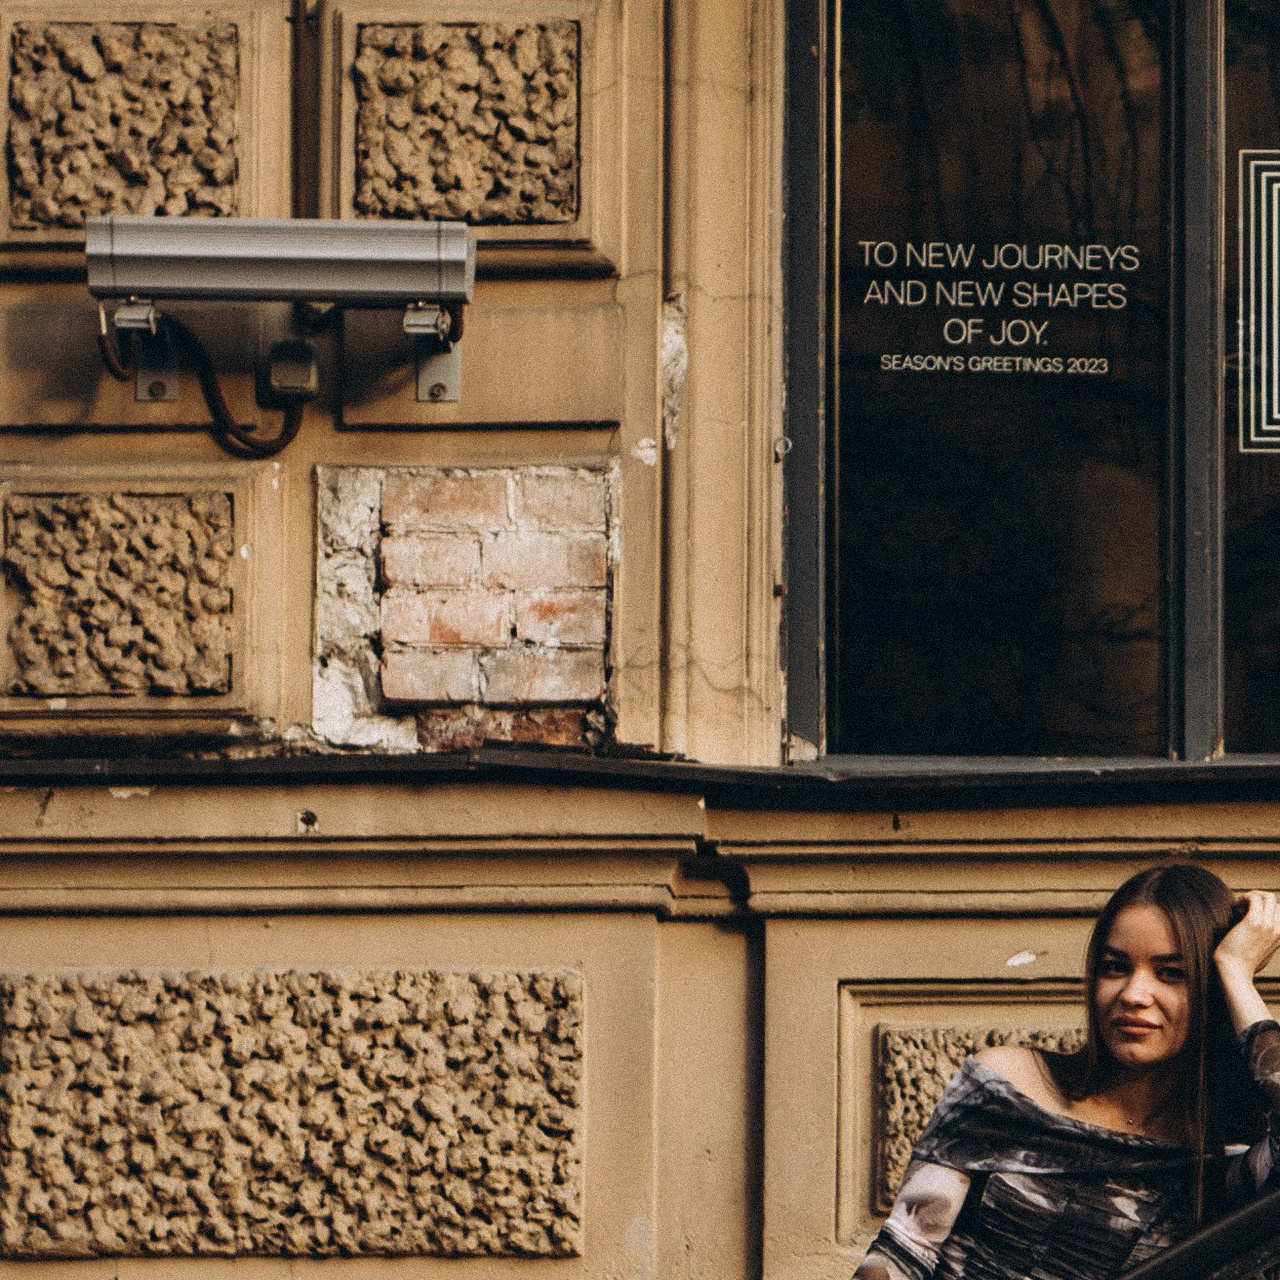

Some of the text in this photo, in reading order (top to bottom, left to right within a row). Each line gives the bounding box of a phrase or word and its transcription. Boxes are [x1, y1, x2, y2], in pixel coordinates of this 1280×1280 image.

[858, 241, 1140, 270] TO NEW JOURNEYS
[863, 280, 1127, 309] AND NEW SHAPES
[943, 318, 1048, 345] OF JOY.
[880, 354, 1108, 373] SEASON'S GREETINGS 2023
